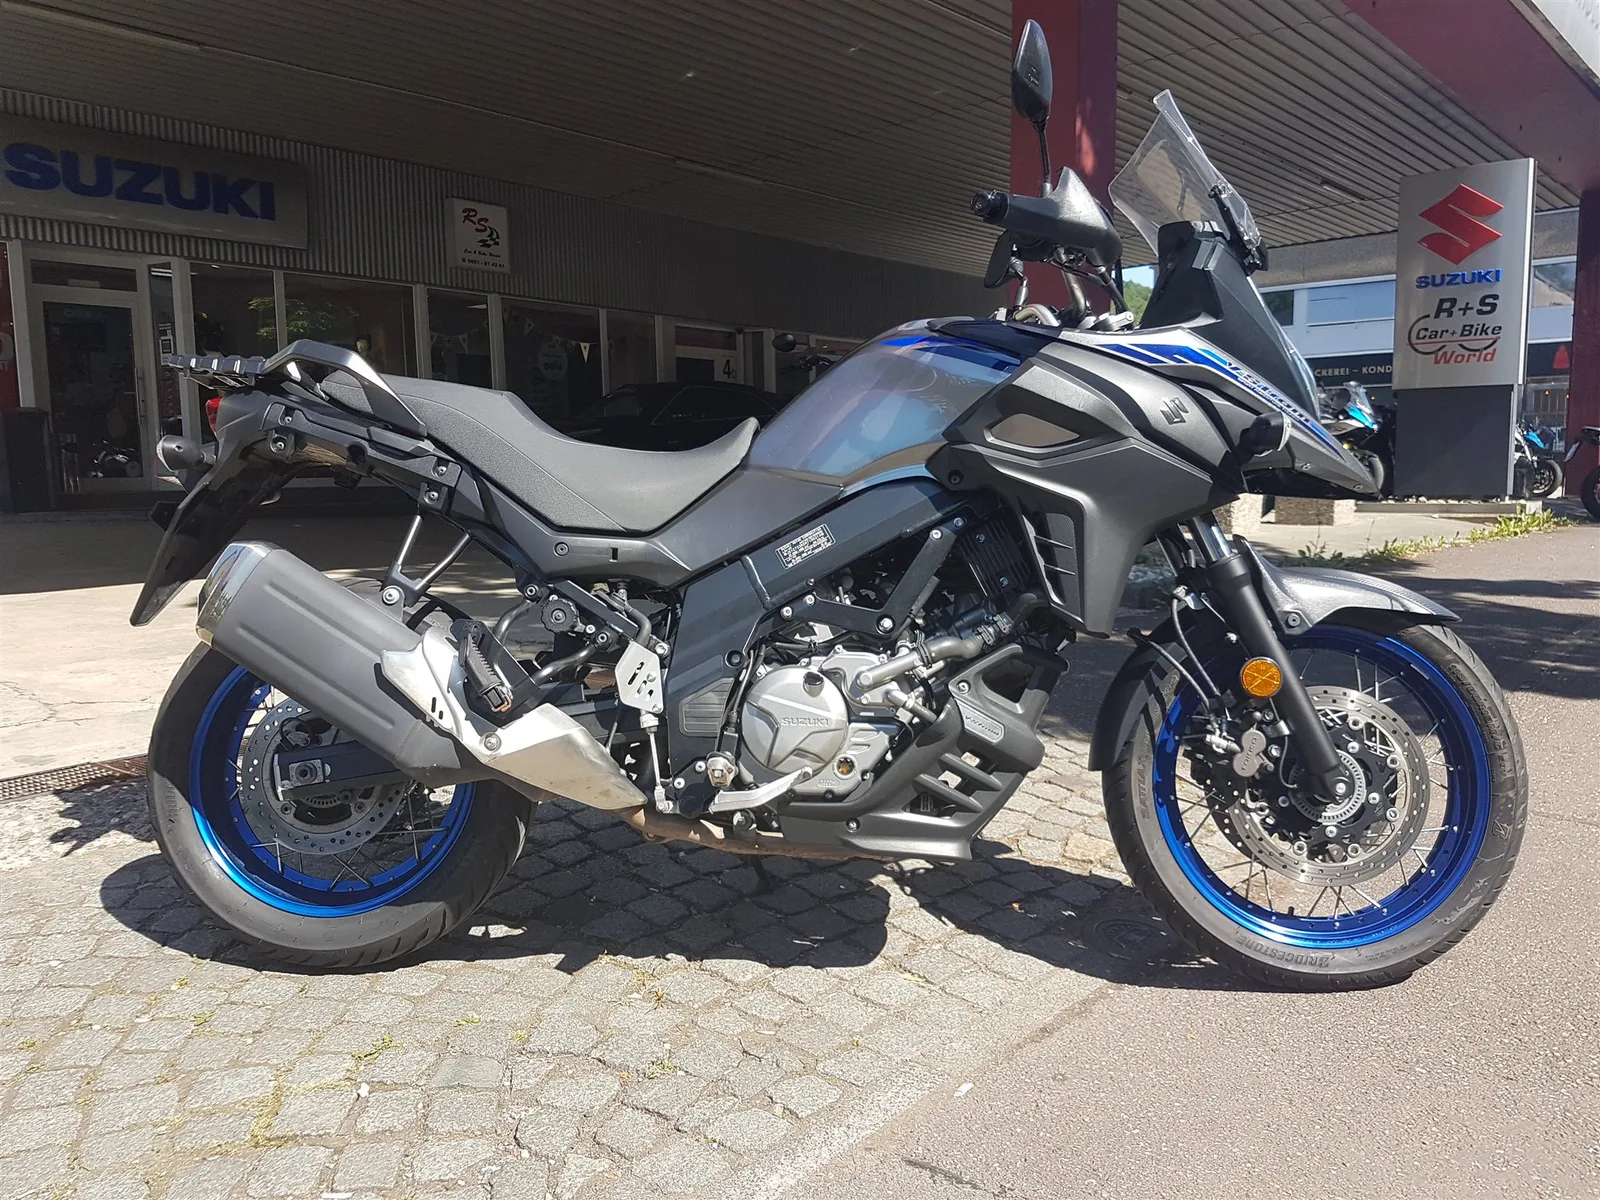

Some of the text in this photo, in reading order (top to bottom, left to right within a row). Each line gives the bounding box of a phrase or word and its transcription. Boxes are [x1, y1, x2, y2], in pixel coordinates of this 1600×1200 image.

[4, 142, 275, 221] SUZUKI
[1415, 268, 1502, 289] SUZUKI
[1433, 294, 1499, 319] R+S
[1433, 348, 1497, 365] World
[1312, 367, 1349, 377] CKEREI
[781, 717, 829, 726] SUZUKI
